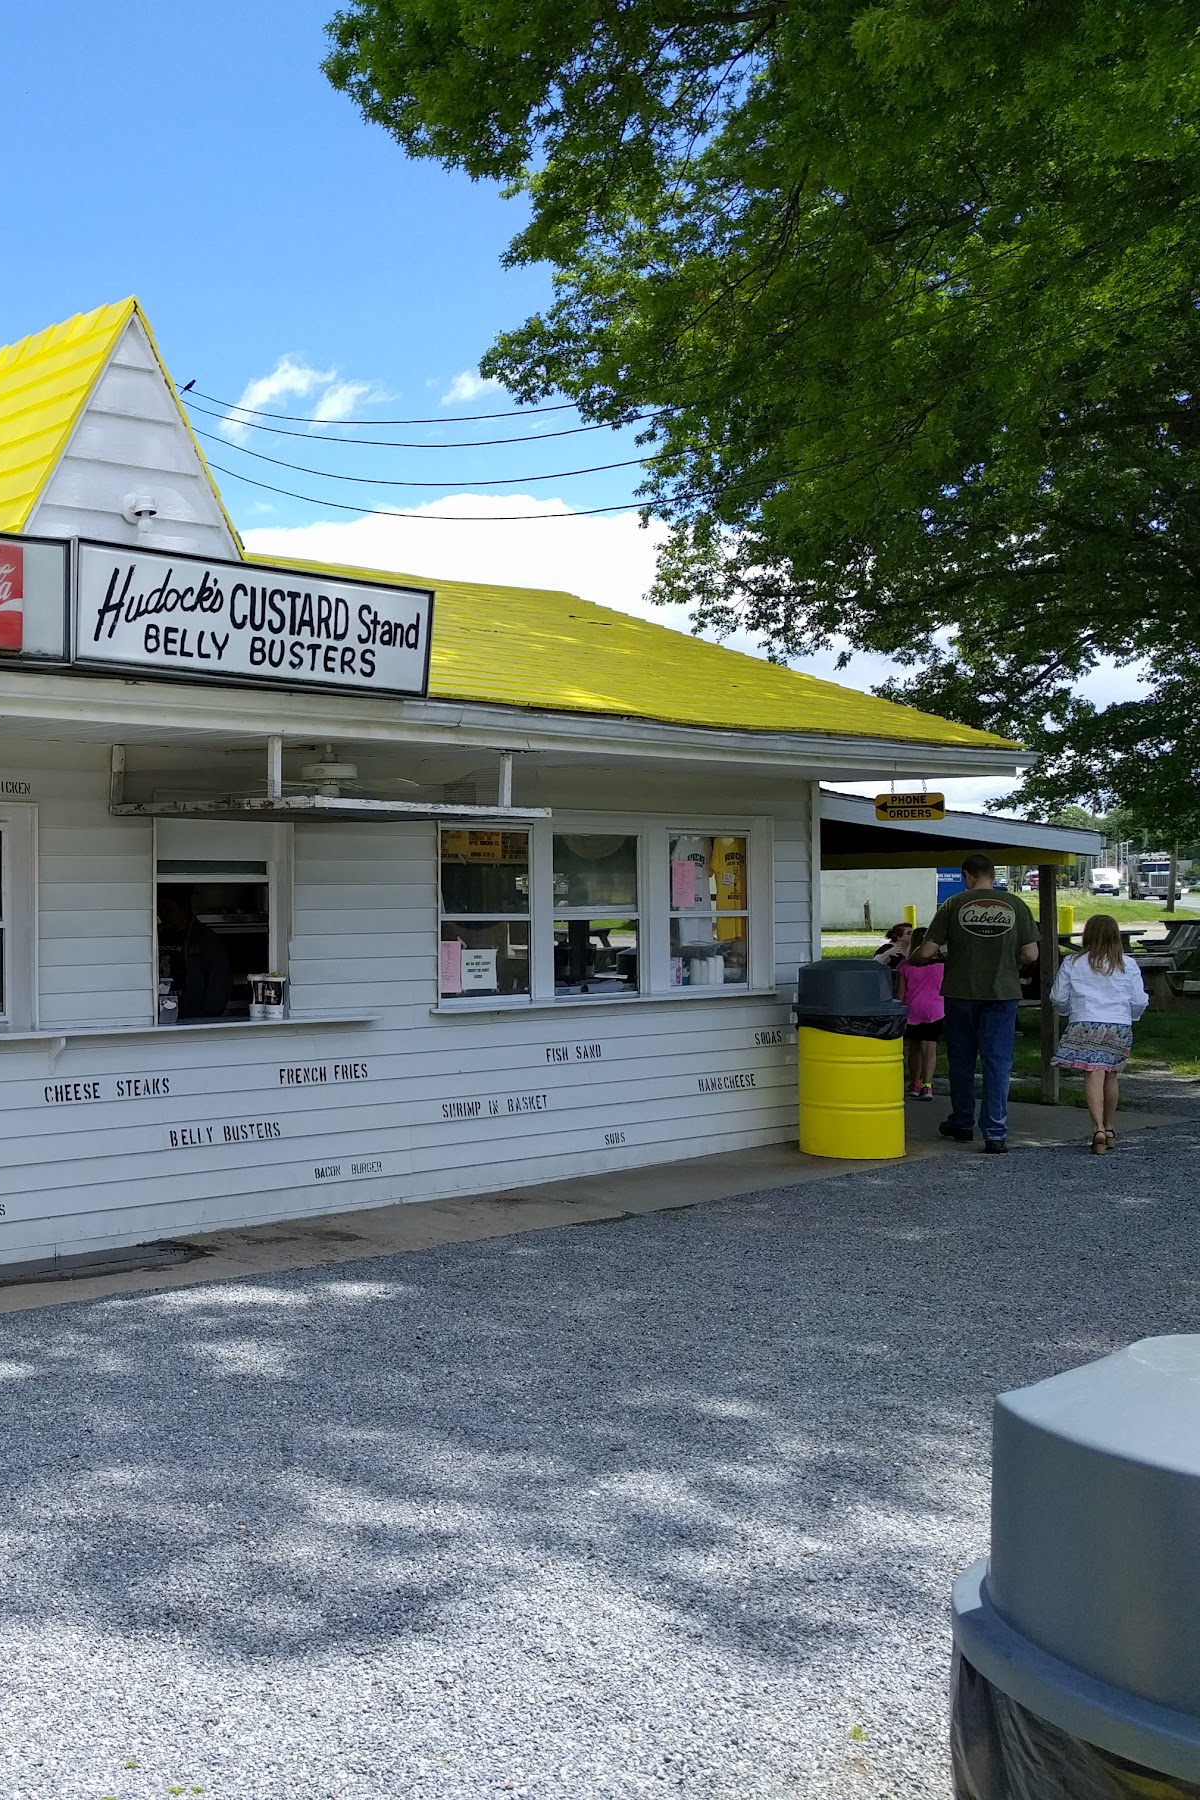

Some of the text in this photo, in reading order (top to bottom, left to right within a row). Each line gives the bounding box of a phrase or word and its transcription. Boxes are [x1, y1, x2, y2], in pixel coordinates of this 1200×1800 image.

[93, 564, 420, 650] Hudock's CUSTARD Stand
[144, 623, 376, 678] BELLY BUSTERS
[890, 795, 927, 805] PHONE
[889, 809, 932, 818] ORDERS
[962, 909, 1012, 924] Cabela's
[754, 1030, 782, 1045] SODAS
[545, 1044, 602, 1062] FISH SAND
[279, 1063, 368, 1084] FRENCH FRIES
[44, 1077, 170, 1102] CHEESE STEAKS
[441, 1094, 548, 1118] SHRIMP IN BASKET
[169, 1121, 281, 1147] BELLY BUSTERS
[604, 1131, 626, 1145] SUBS
[314, 1161, 383, 1179] BACON BURGER
